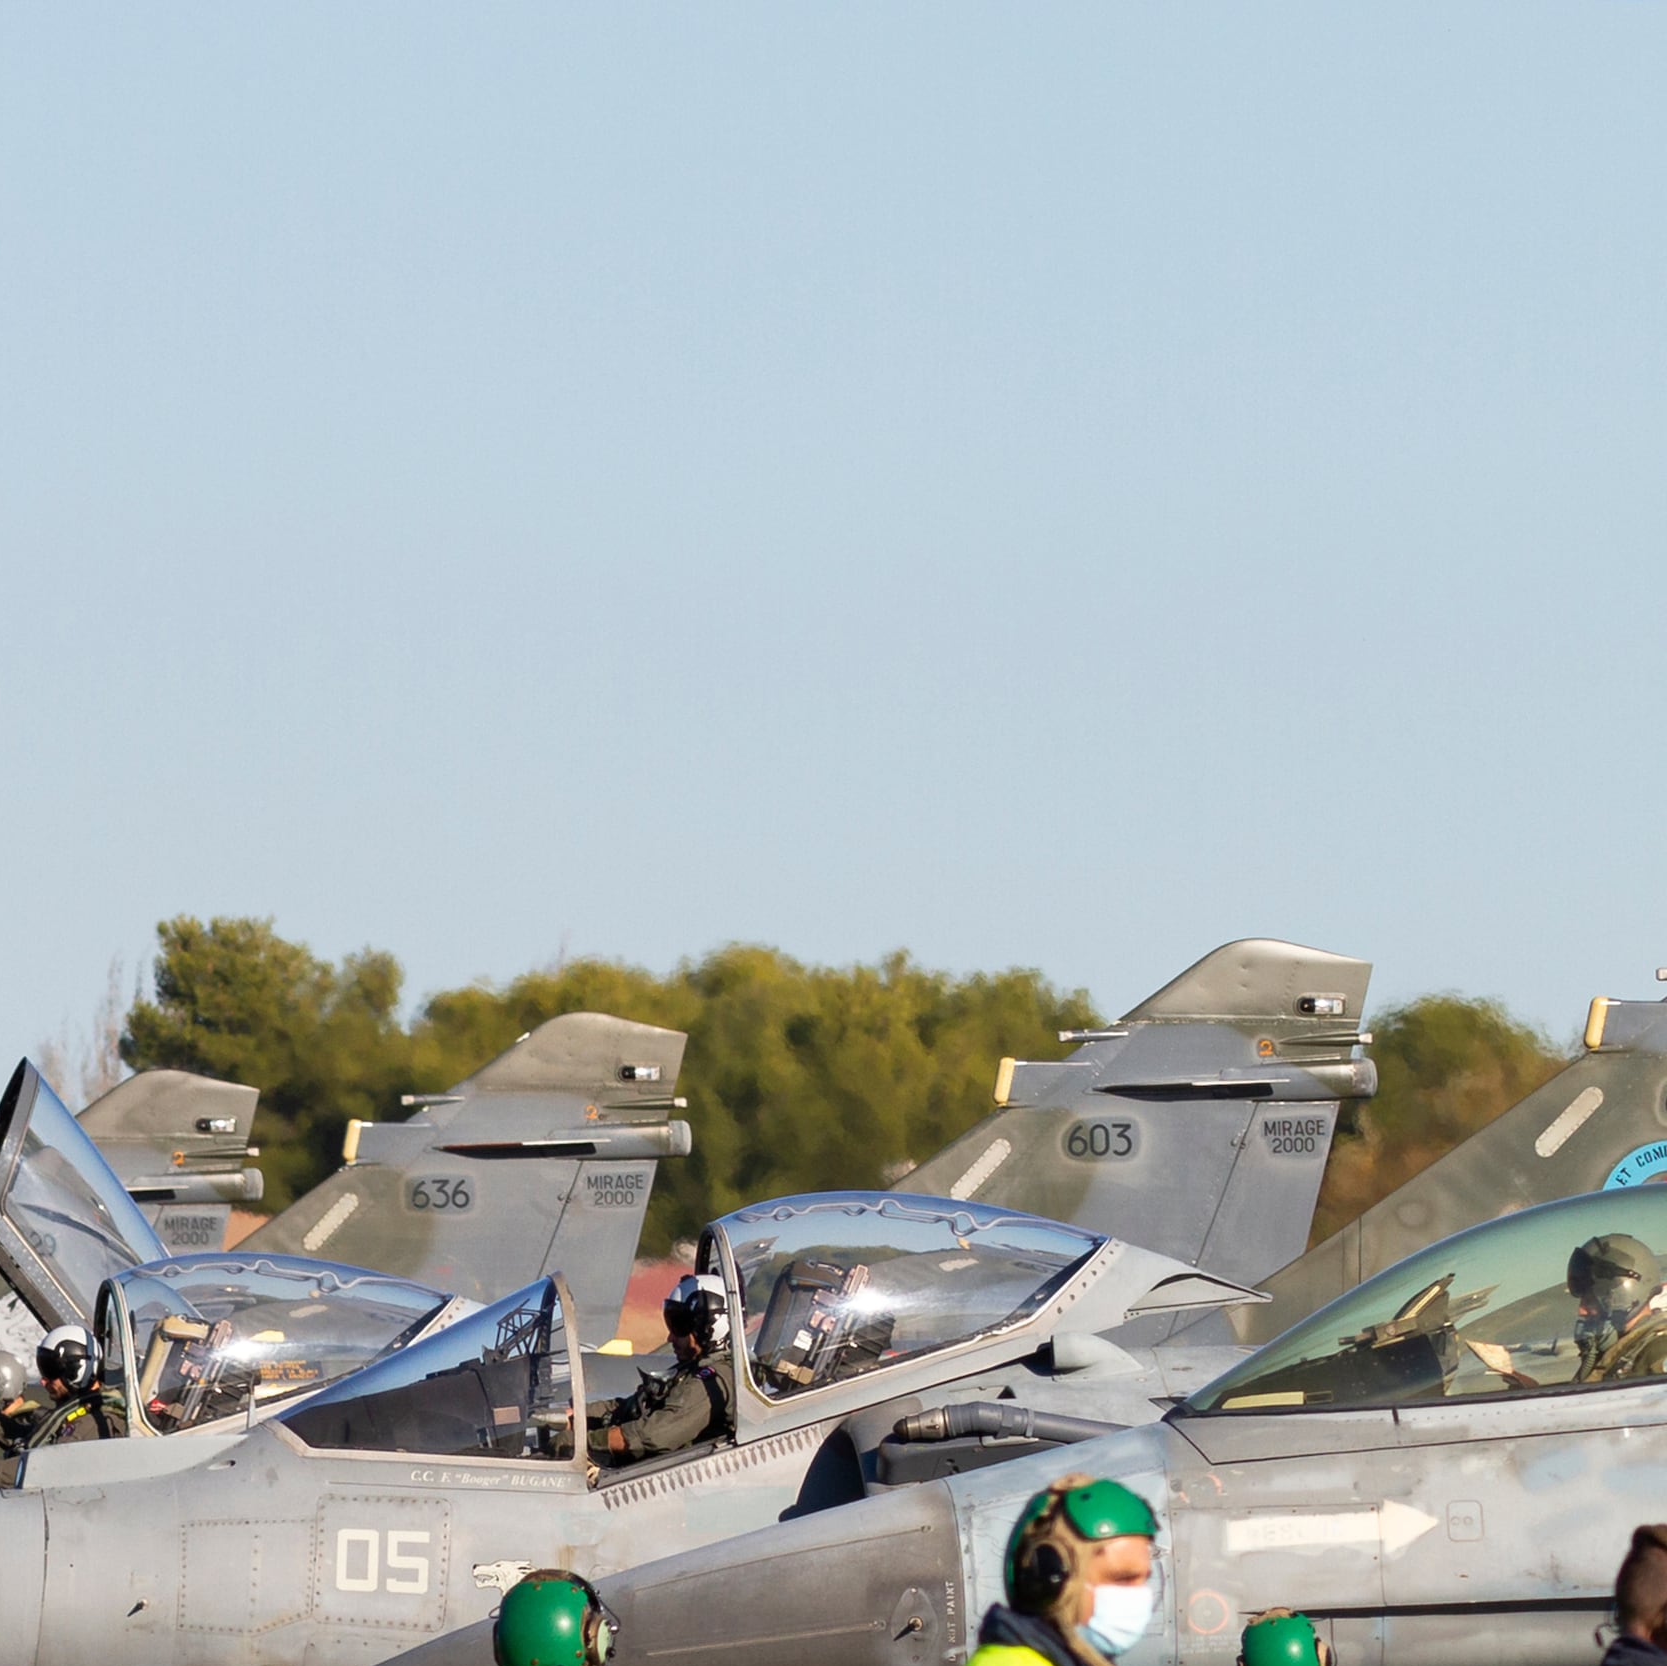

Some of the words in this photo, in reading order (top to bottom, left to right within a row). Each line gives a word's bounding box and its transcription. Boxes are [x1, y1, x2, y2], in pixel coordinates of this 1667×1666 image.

[1263, 1120, 1325, 1136] MIRAGE
[1068, 1123, 1133, 1157] 603
[1271, 1137, 1315, 1153] 2000
[587, 1174, 644, 1190] MIRAGE
[412, 1179, 471, 1209] 636
[594, 1190, 634, 1205] 2000
[165, 1216, 217, 1231] MIRAGE
[171, 1231, 210, 1245] 2000
[336, 1528, 430, 1594] 05
[945, 1581, 955, 1616] PAINT
